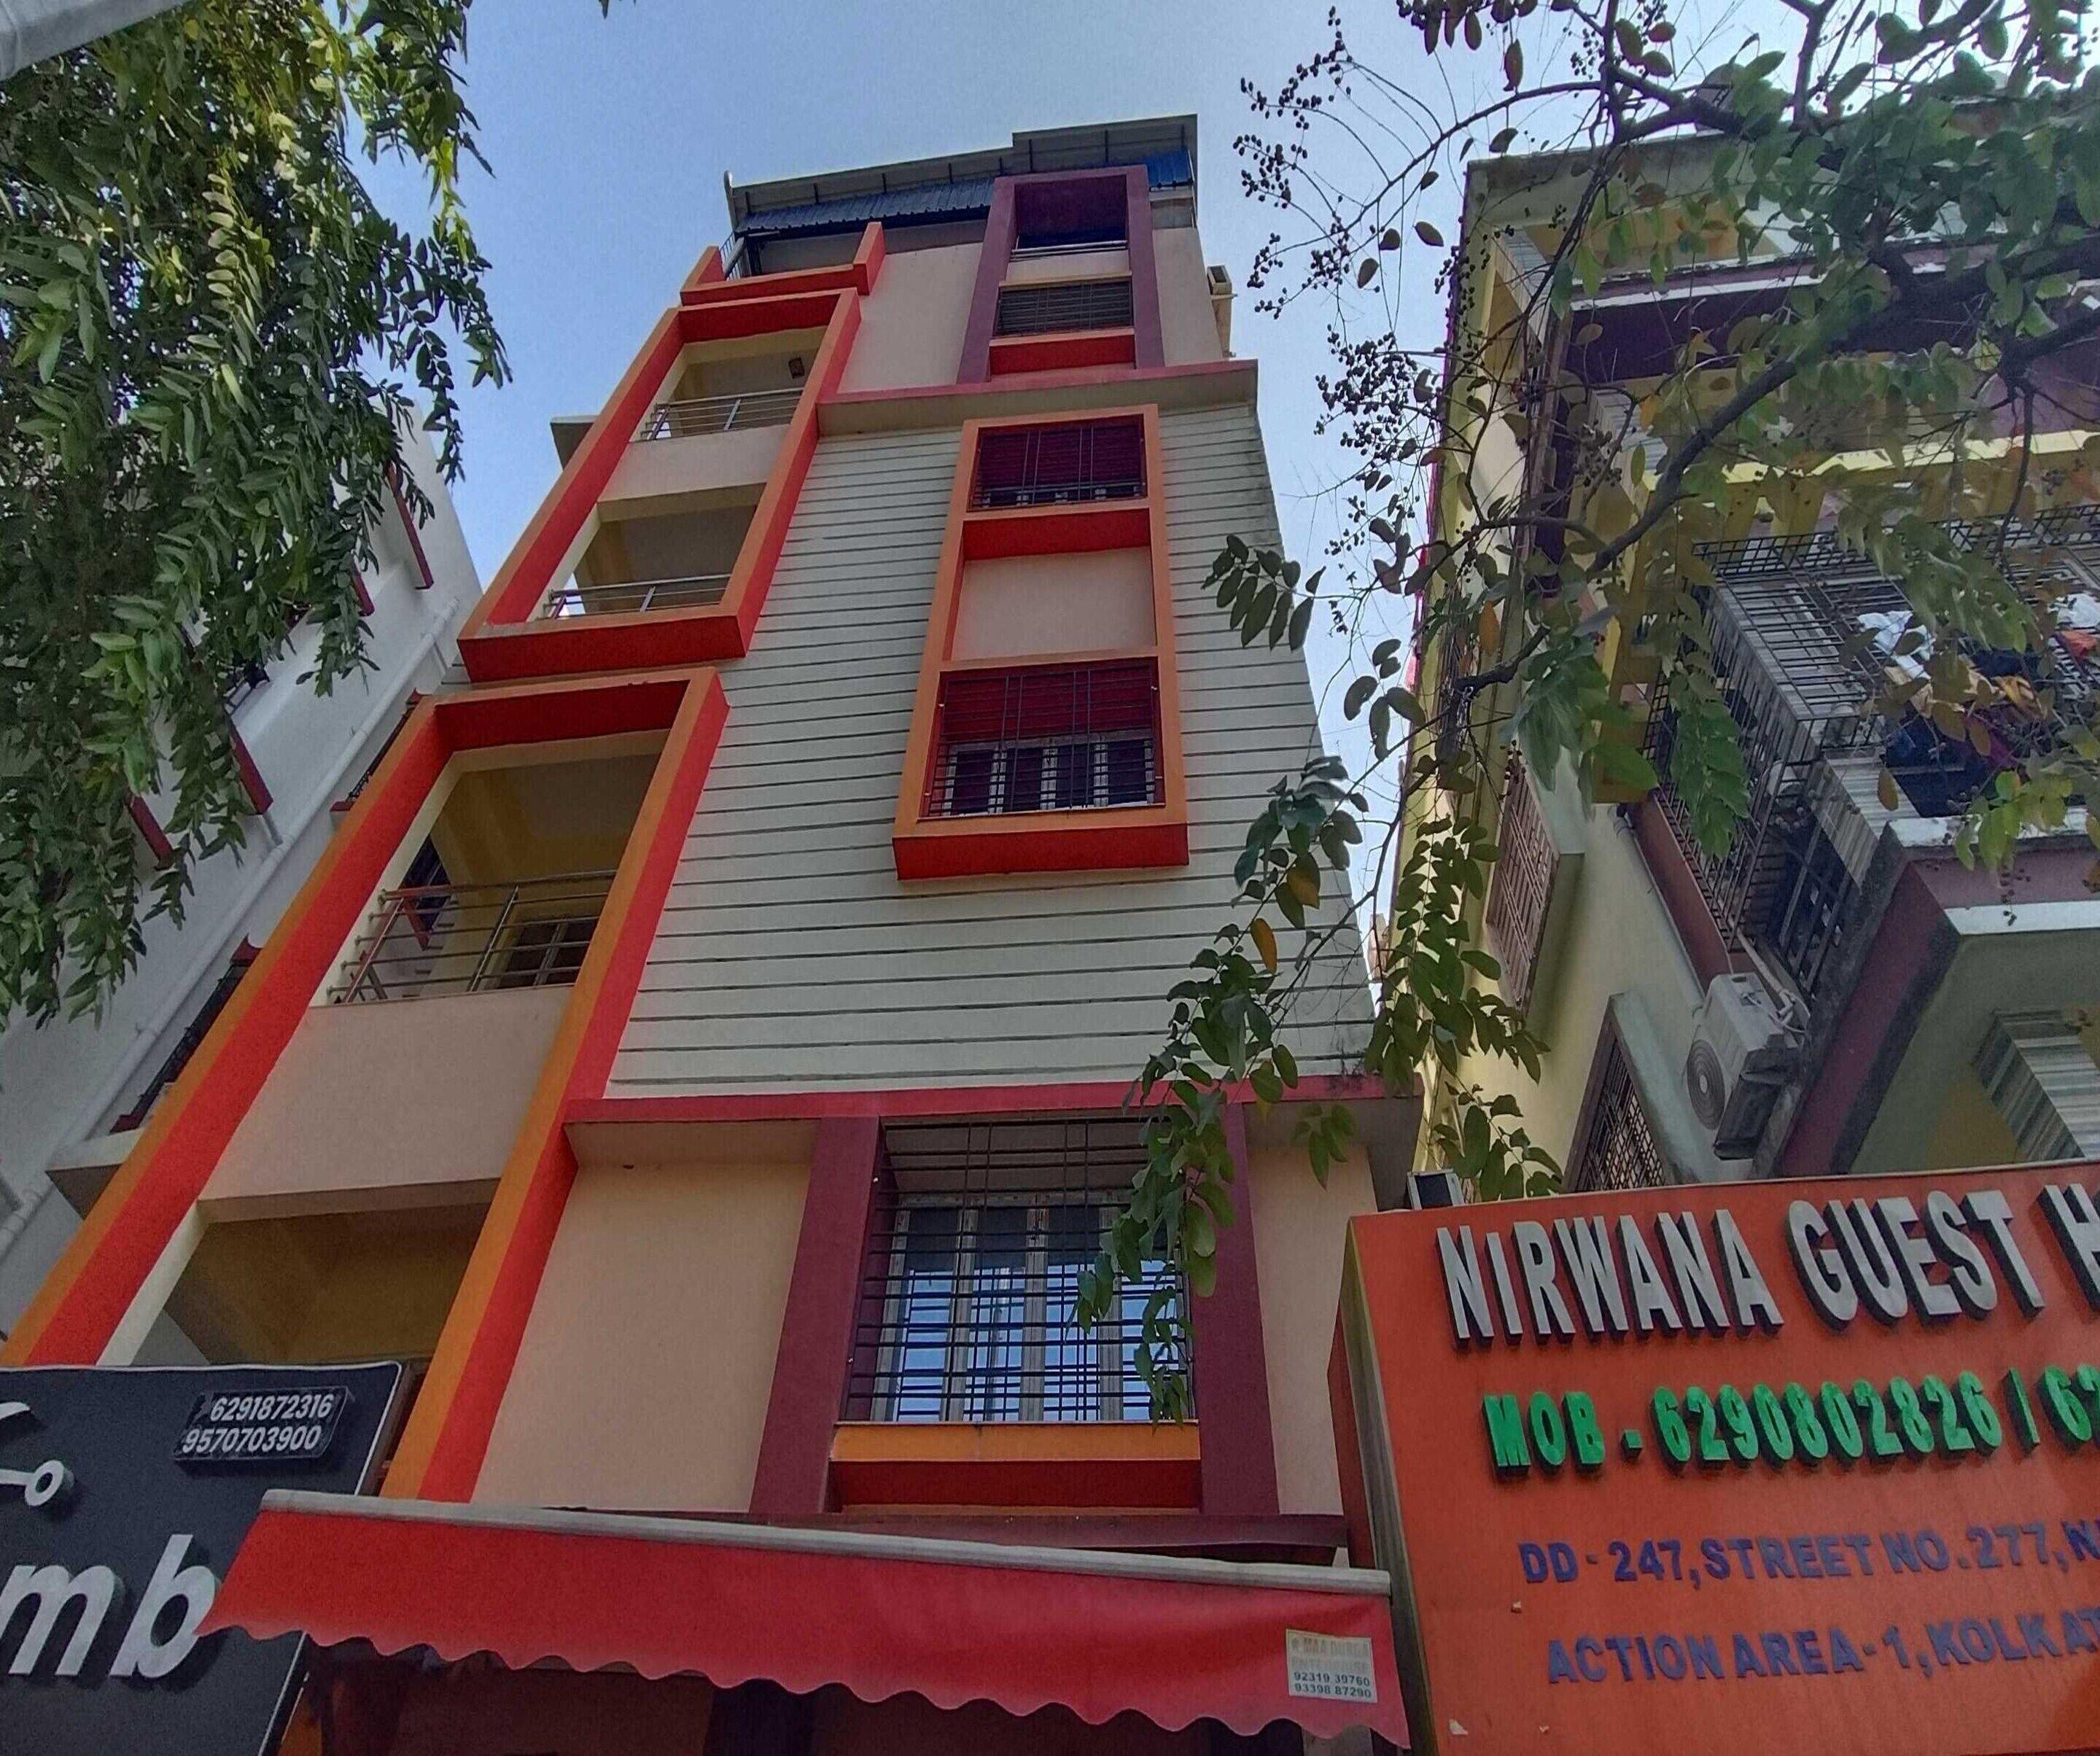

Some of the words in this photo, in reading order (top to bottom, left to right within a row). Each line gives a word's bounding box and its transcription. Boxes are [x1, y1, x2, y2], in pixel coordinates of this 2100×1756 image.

[1435, 1208, 1784, 1342] NIRWANA
[1788, 1189, 2045, 1321] GUEST
[210, 1394, 334, 1421] 6291872316
[1653, 1371, 2003, 1462] 6290802826
[182, 1424, 322, 1453] 9570703900
[1547, 1634, 1725, 1684] ACTION
